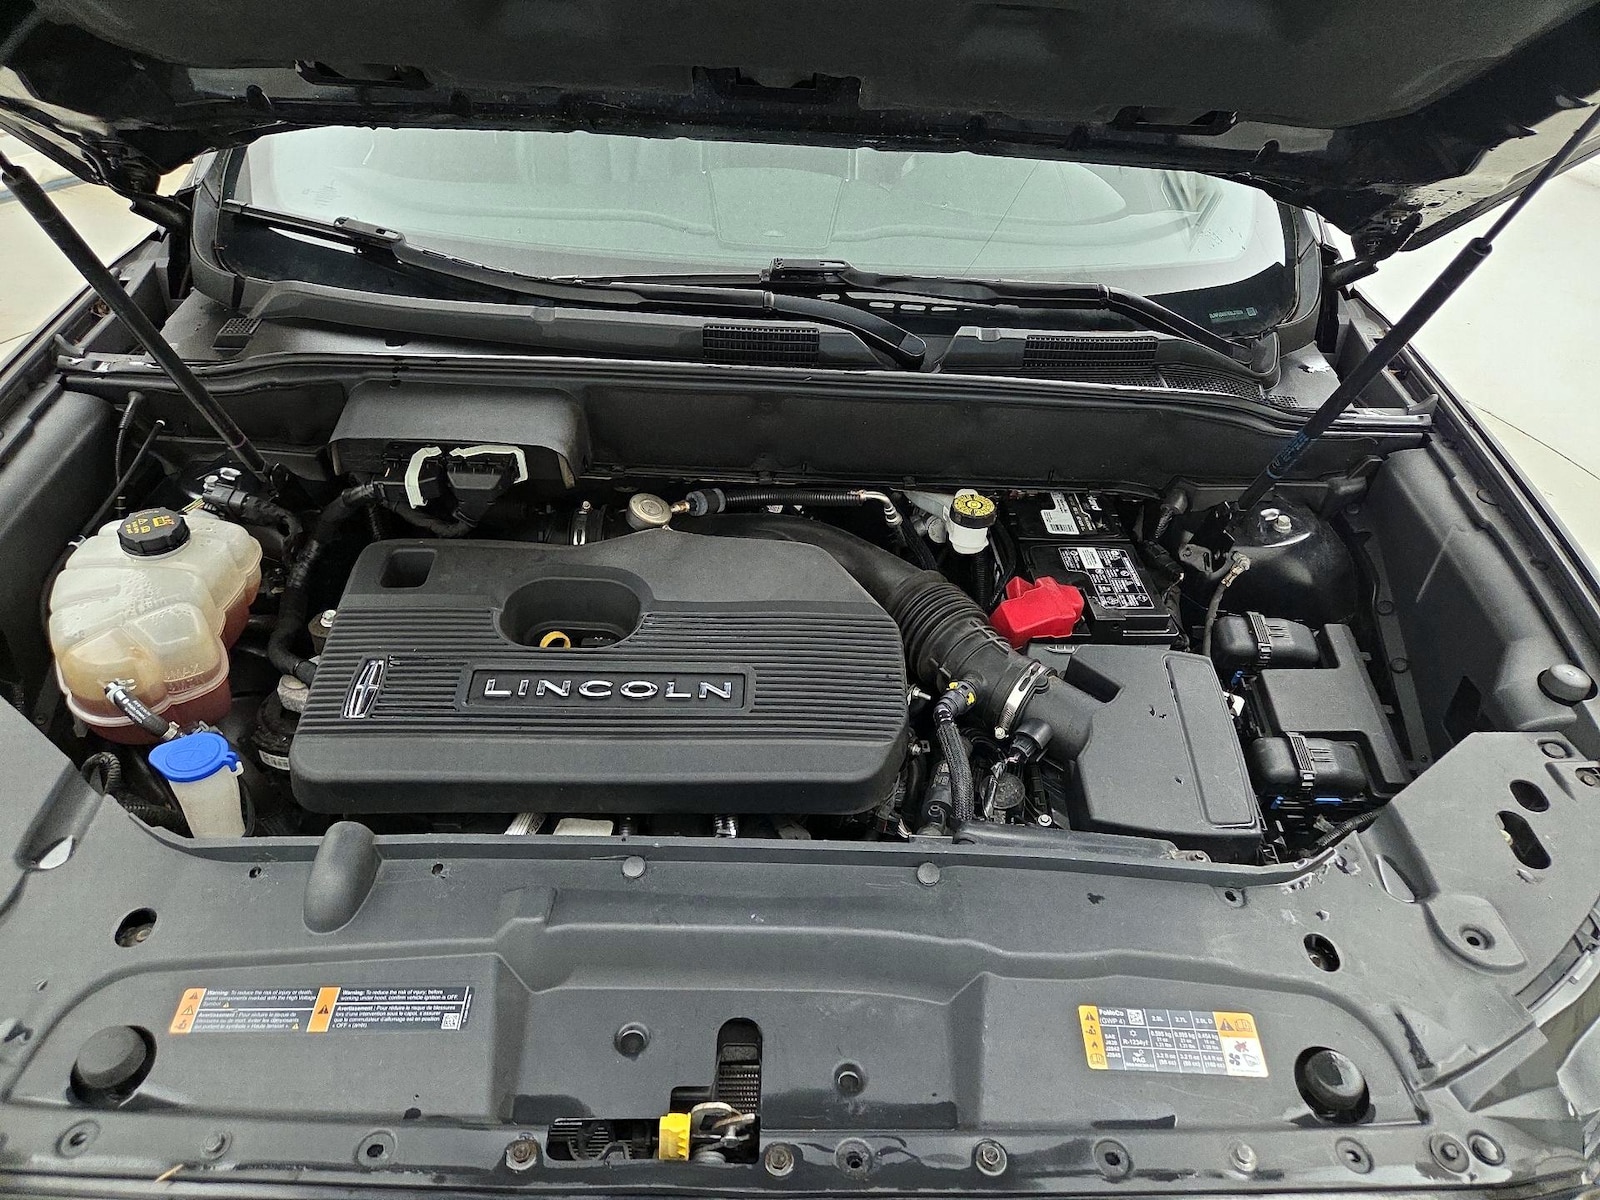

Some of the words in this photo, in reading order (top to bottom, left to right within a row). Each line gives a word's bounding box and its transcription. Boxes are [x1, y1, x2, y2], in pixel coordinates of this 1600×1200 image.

[484, 678, 732, 699] LINCOLN
[278, 989, 291, 997] injury
[1099, 1009, 1125, 1017] FoMoCo
